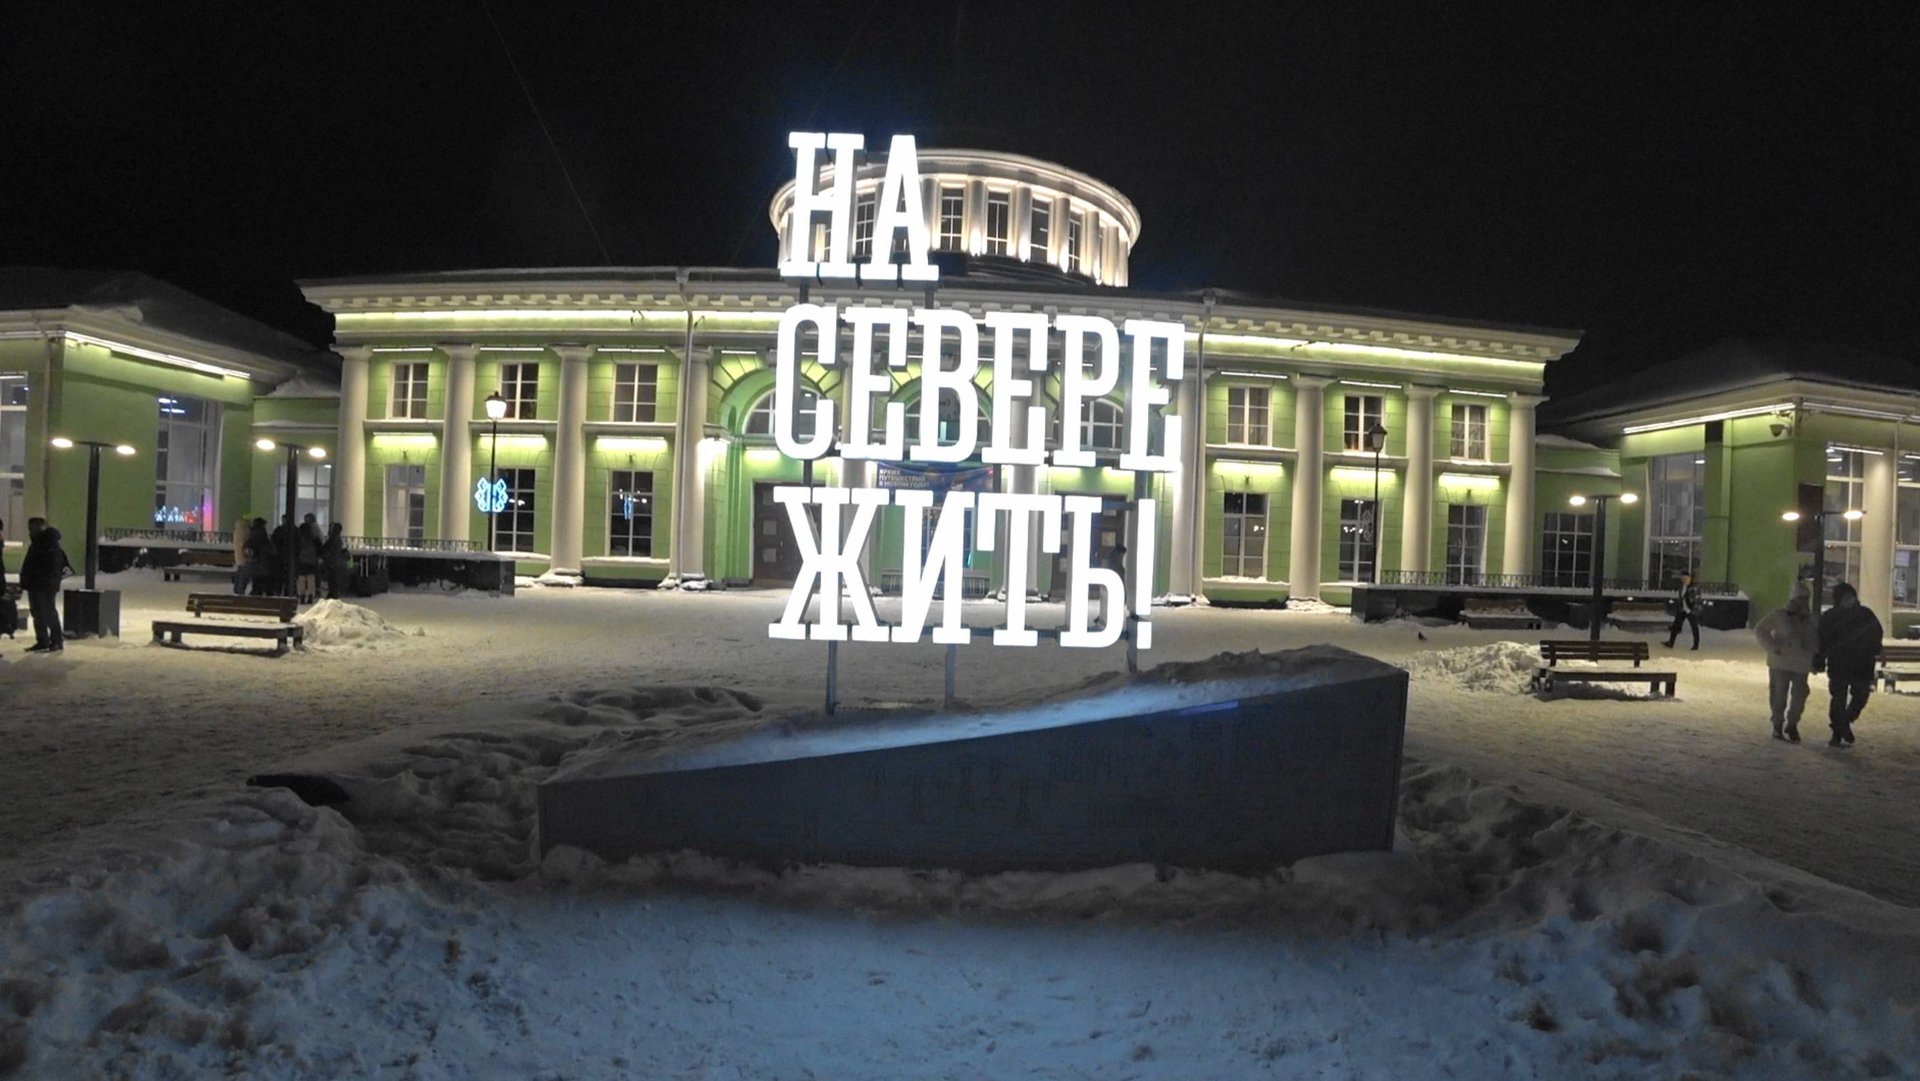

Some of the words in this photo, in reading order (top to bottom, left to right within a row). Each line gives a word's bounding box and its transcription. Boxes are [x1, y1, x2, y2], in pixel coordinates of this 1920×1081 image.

[781, 132, 939, 280] НА
[775, 303, 1184, 472] СЕВЕРЕ
[768, 486, 1155, 650] ЖИТЬ!
